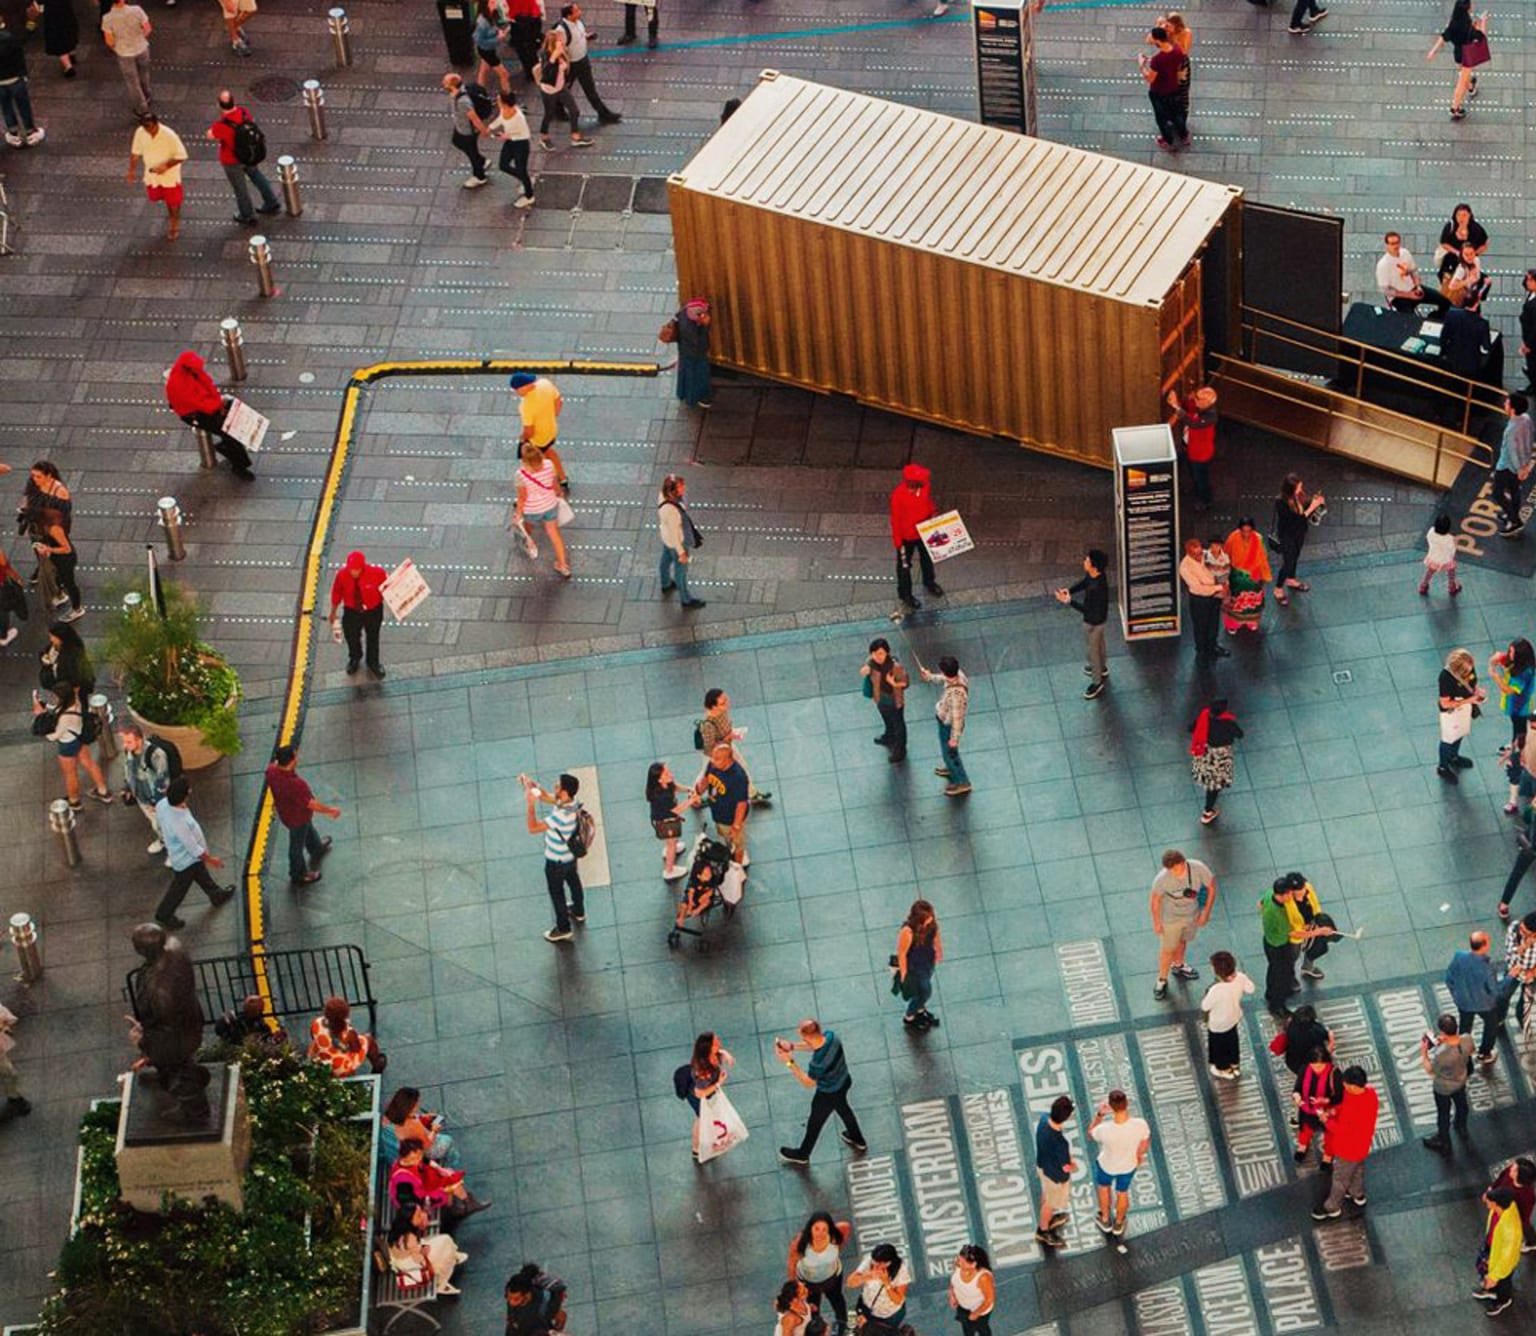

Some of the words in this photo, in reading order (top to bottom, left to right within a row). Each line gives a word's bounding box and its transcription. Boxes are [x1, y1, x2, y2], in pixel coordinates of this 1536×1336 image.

[1143, 1027, 1201, 1103] IMPERIAL
[963, 1092, 999, 1175] AMERICAN
[987, 1088, 1021, 1171] AIRLINES
[1215, 1074, 1278, 1166] FONTANNE
[901, 1099, 970, 1257] AMSTERDAM
[1167, 1144, 1191, 1172] BOX
[1173, 1170, 1200, 1216] MUSIC
[1192, 1140, 1225, 1208] MARQUIS
[1236, 1159, 1282, 1195] LUNT
[980, 1174, 1042, 1266] LYRIC
[1072, 1183, 1107, 1249] HAYES
[929, 1259, 955, 1277] NE
[1257, 1244, 1321, 1333] PALACE
[1136, 1286, 1191, 1336] LASCO
